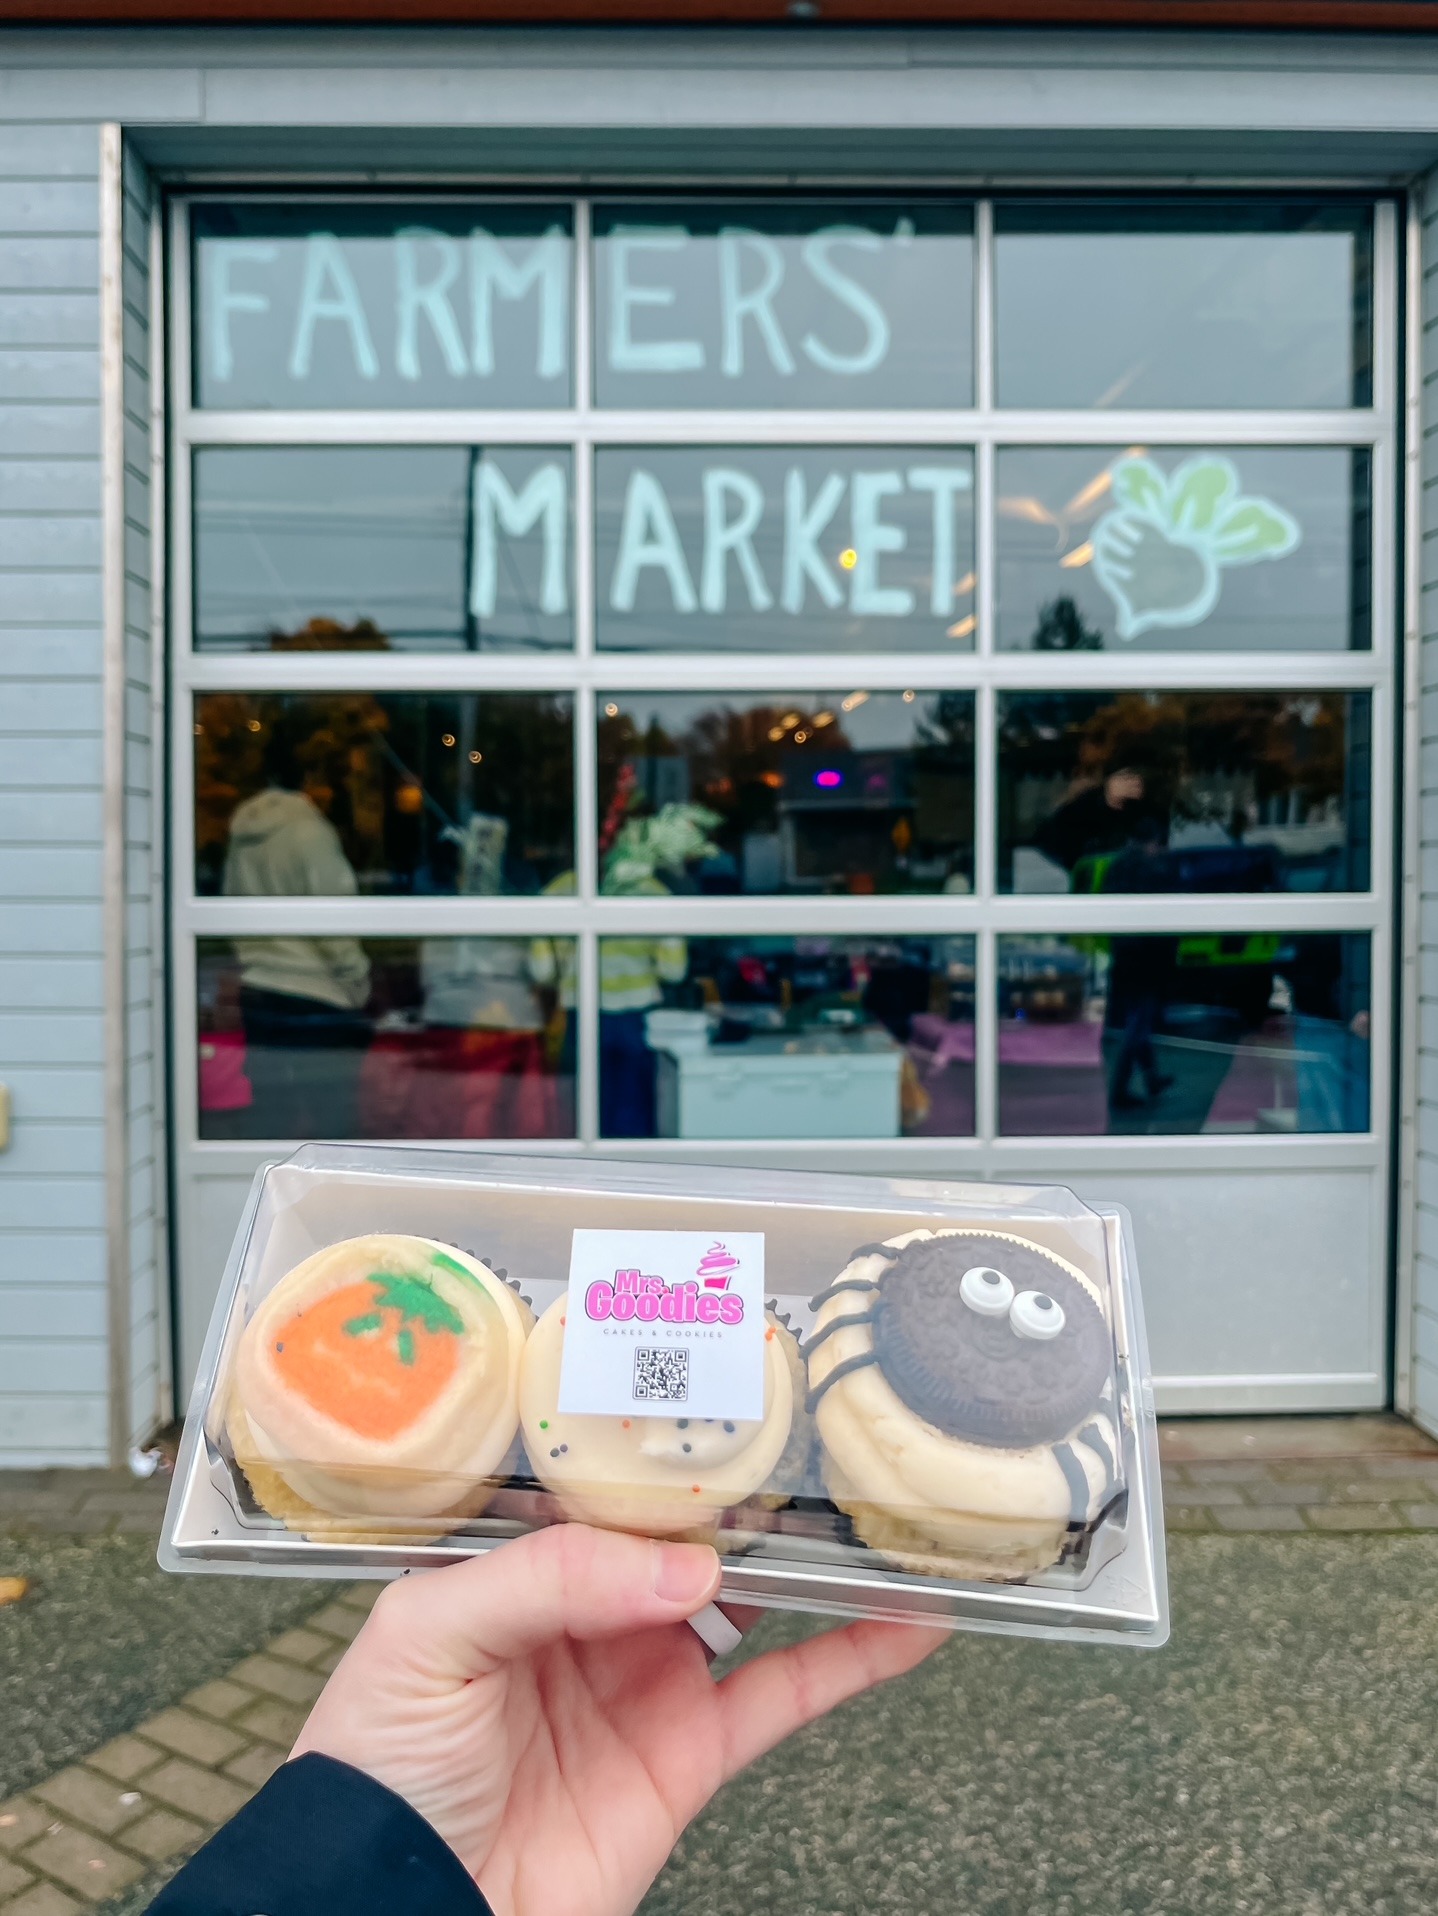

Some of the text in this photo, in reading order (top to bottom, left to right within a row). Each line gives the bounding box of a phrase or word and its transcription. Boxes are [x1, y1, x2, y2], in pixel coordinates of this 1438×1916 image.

[207, 216, 915, 381] FARMERS'
[470, 460, 973, 618] MARKET
[585, 1280, 744, 1324] Goodies
[614, 1269, 669, 1294] Mrs.
[603, 1328, 643, 1336] CAKES
[666, 1330, 723, 1339] COOKIES
